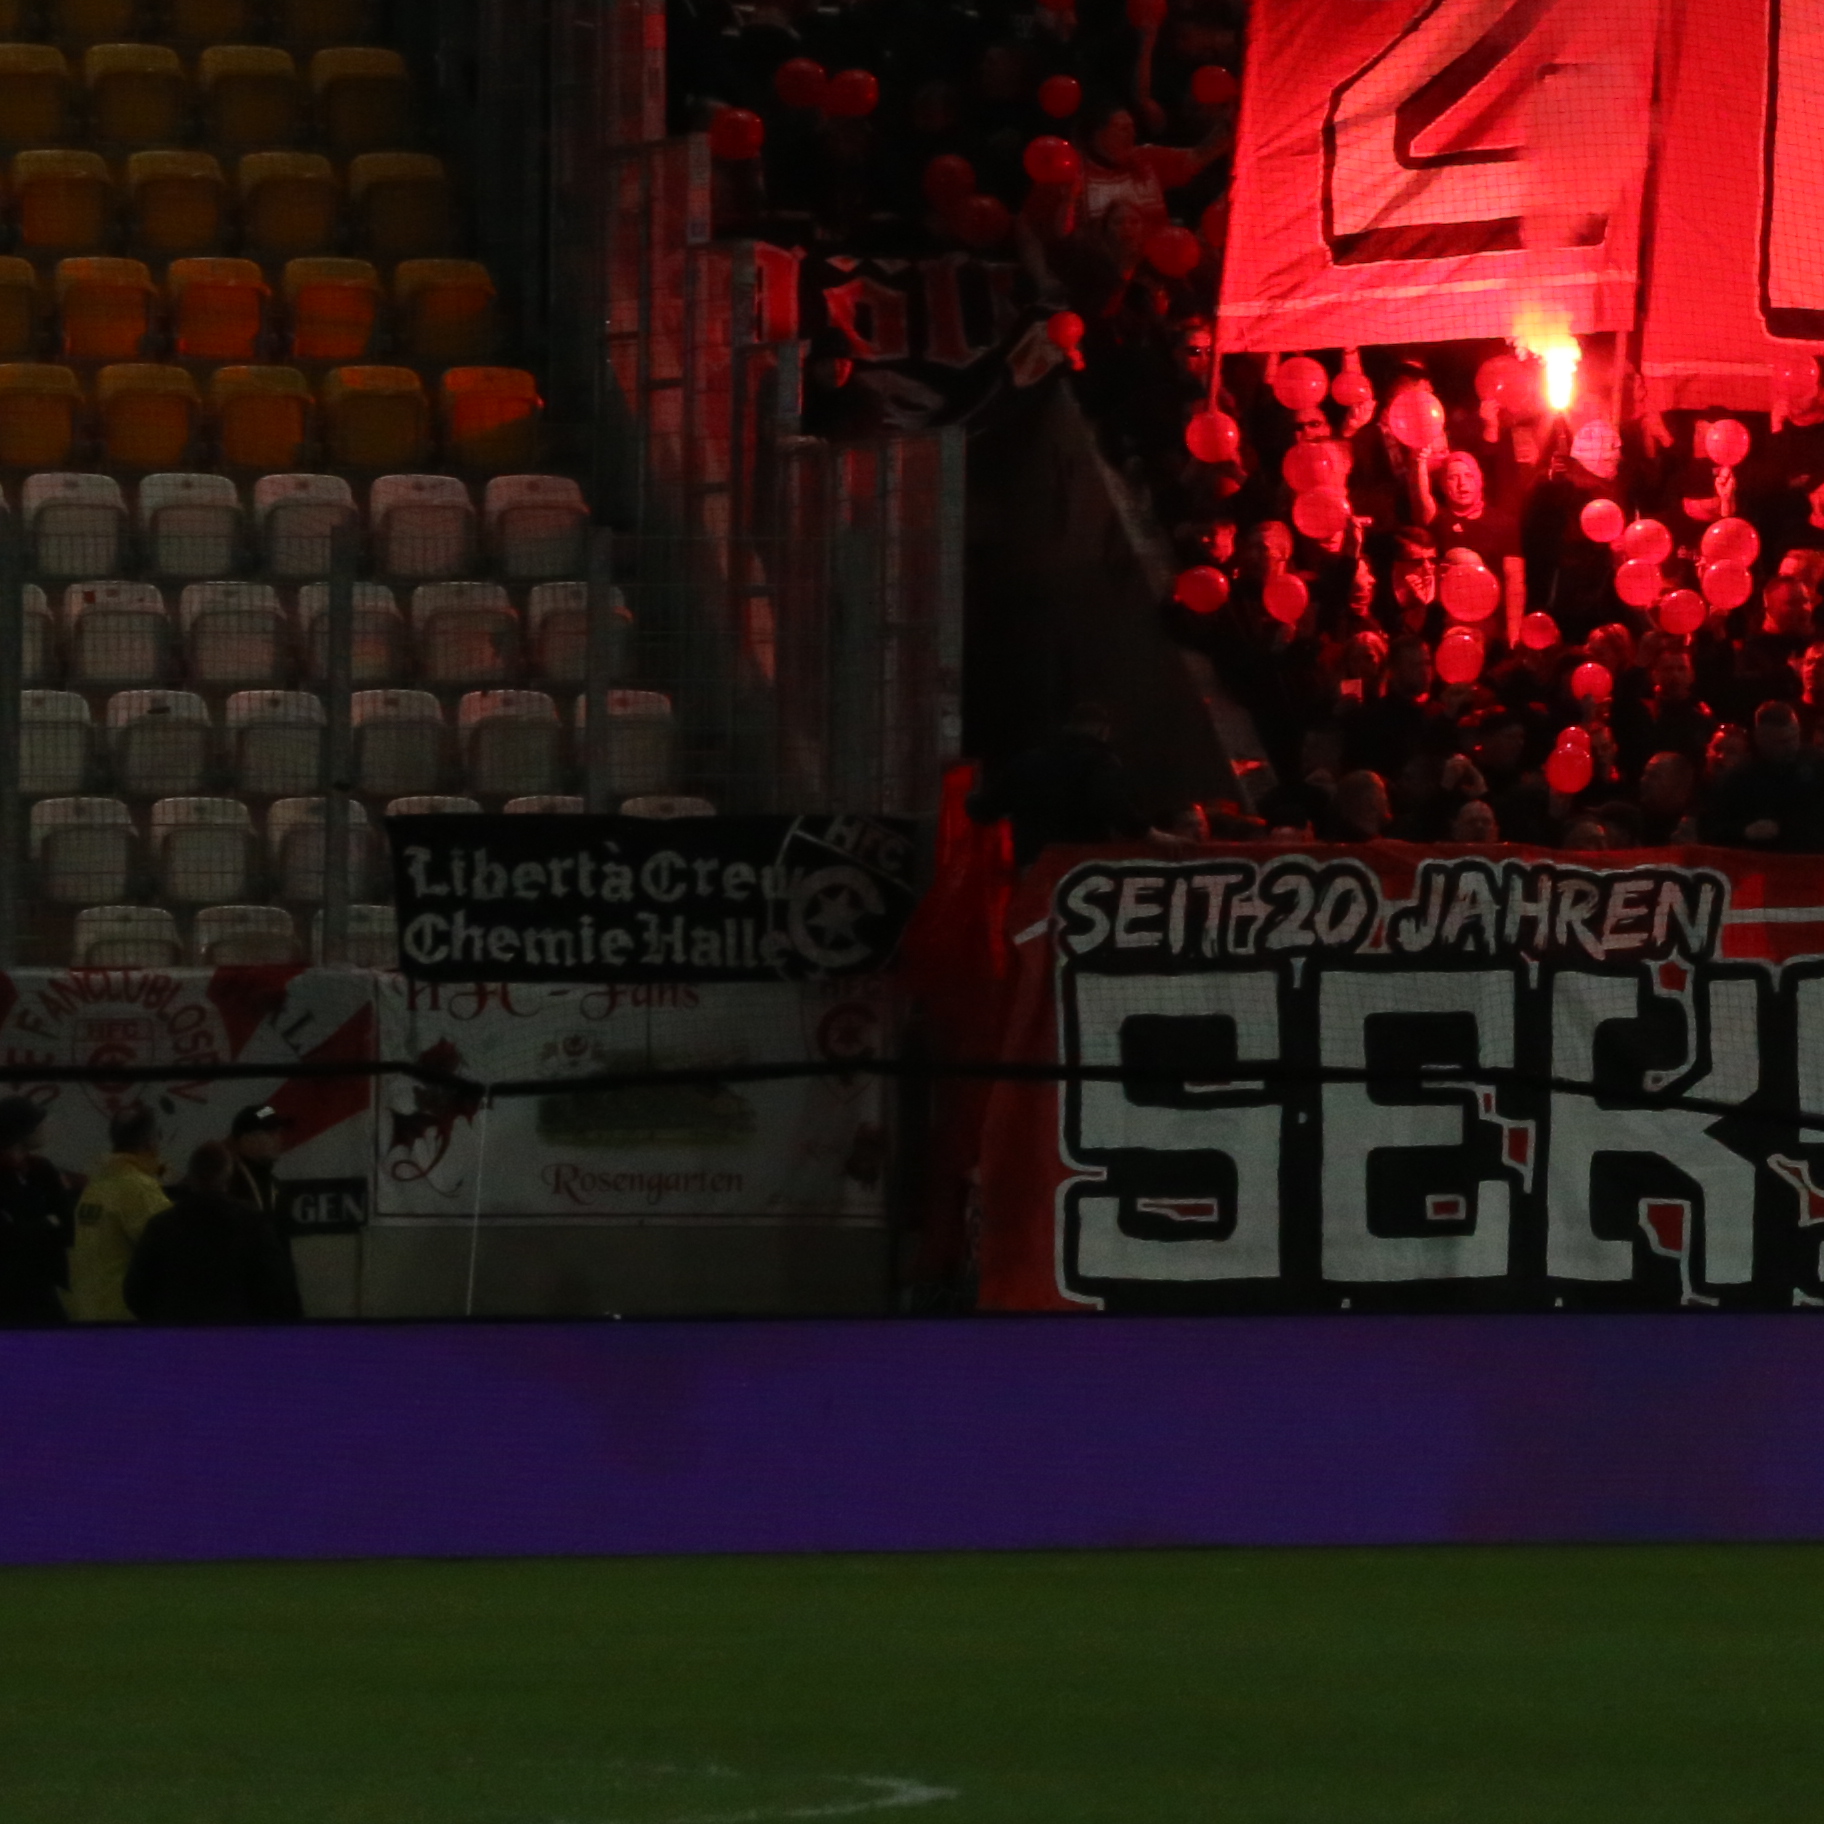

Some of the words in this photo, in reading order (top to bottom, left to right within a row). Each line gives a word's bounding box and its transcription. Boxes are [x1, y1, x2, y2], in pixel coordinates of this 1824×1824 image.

[403, 909, 635, 967] Chemie
[635, 911, 795, 969] Halle
[1065, 873, 1247, 957] SEIT
[1263, 875, 1363, 947] 20
[1398, 871, 1717, 960] JAHREN
